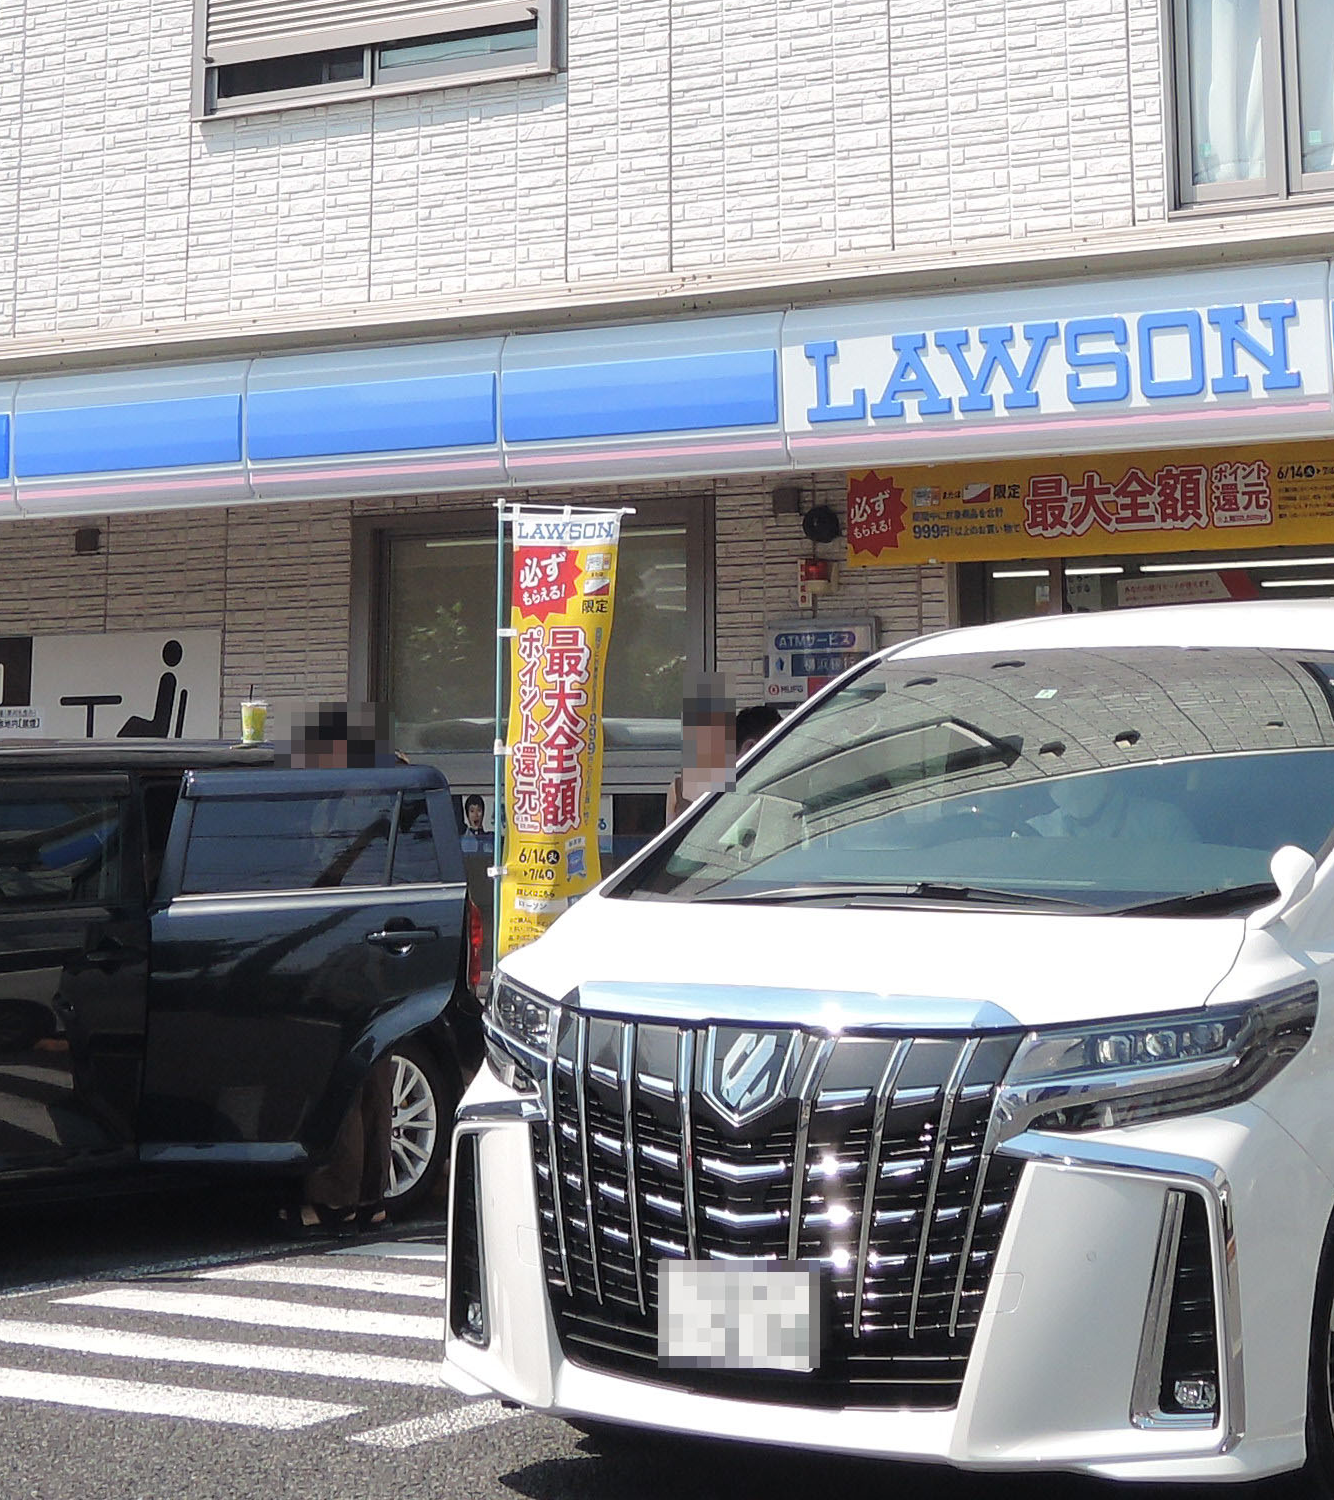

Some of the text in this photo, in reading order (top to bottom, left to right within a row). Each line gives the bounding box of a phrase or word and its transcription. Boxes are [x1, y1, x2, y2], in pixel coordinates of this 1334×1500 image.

[804, 299, 1301, 423] LAWSON
[1213, 461, 1269, 483] ポイント
[850, 488, 891, 524] 必ず
[993, 484, 1021, 499] 限定
[1025, 466, 1206, 533] 最大全額
[1214, 482, 1269, 512] 還元
[517, 521, 615, 541] LAWSON
[519, 551, 567, 588] 必ず
[581, 599, 609, 614] 限定
[542, 629, 587, 828] 最大全額
[518, 900, 548, 911] ローソン
